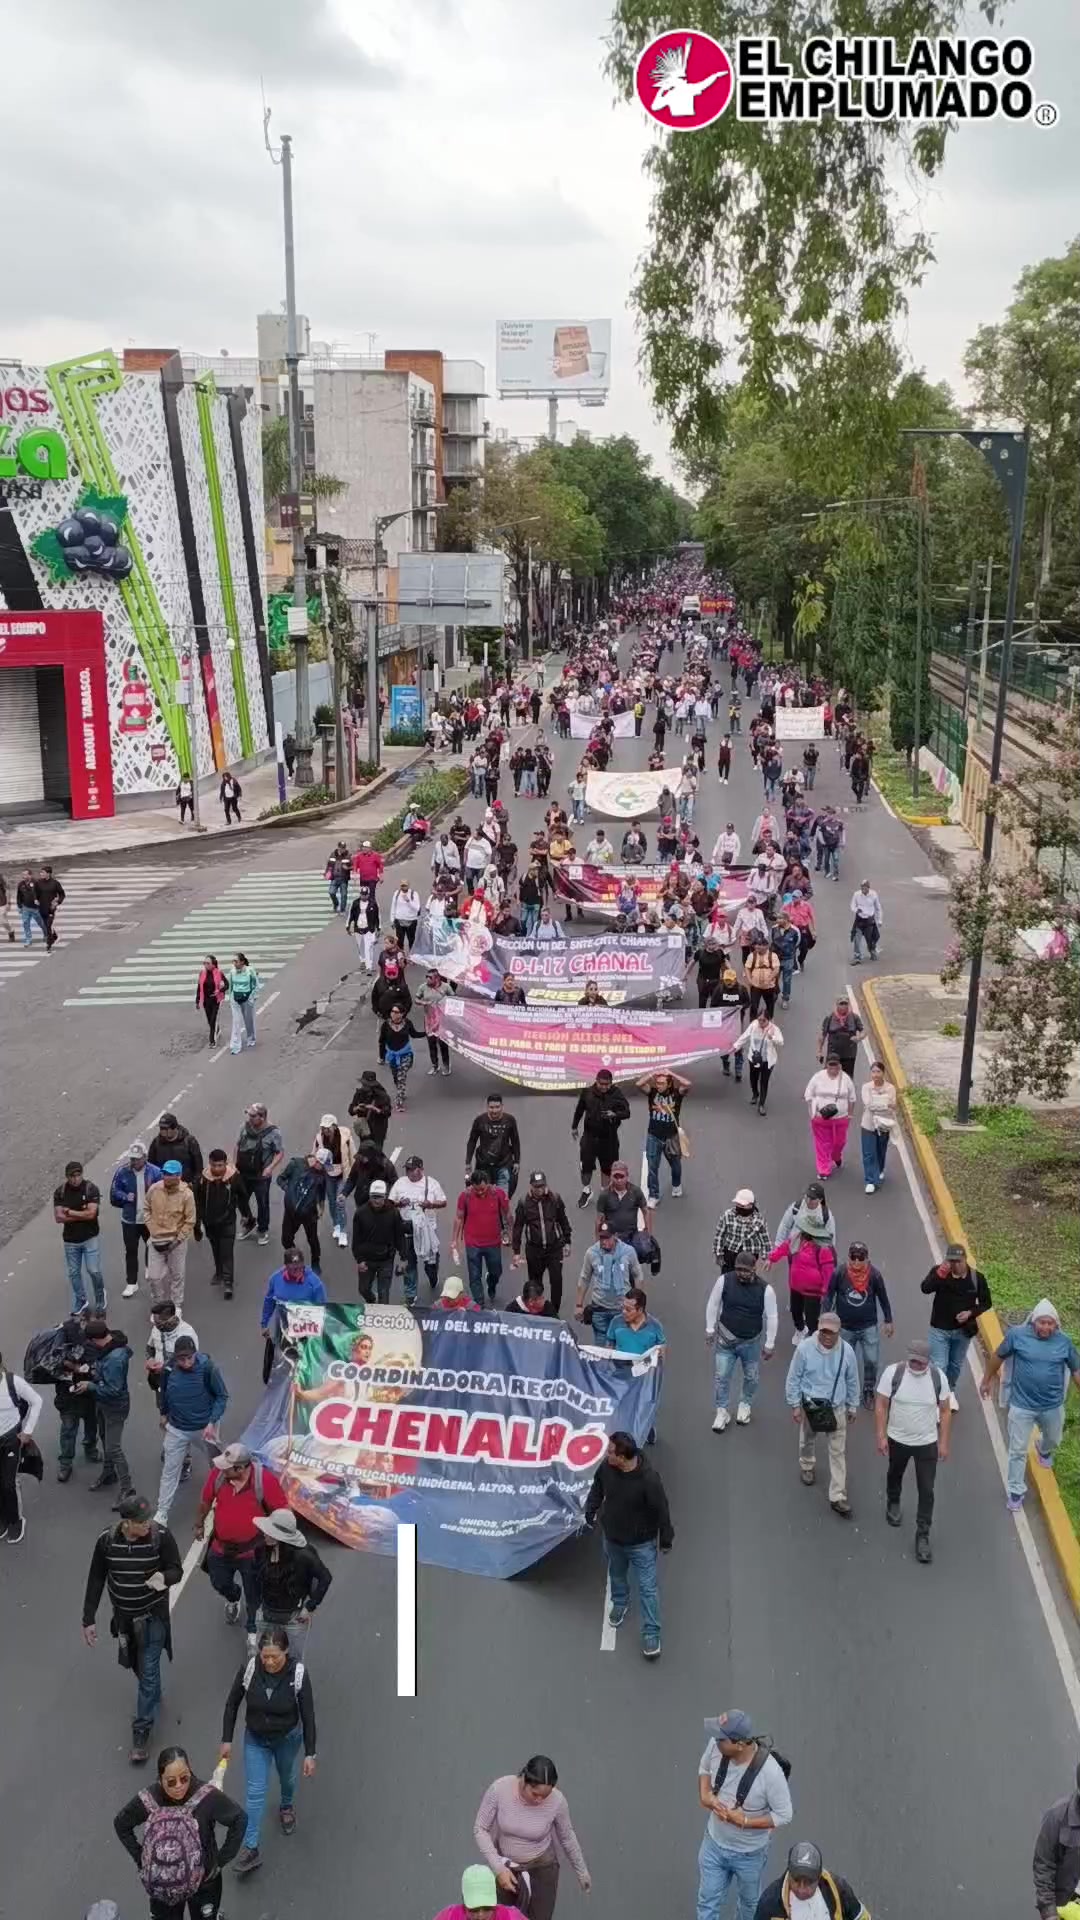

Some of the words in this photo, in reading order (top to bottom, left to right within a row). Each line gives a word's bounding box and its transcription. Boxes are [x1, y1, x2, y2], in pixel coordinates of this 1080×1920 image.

[83, 722, 97, 770] ABSOLUT
[552, 941, 568, 950] DEL
[620, 935, 662, 947] CHIAPAS
[569, 951, 653, 975] CHANAL
[572, 1032, 609, 1042] ALTOS
[356, 1313, 415, 1330] SECCIÓN
[422, 1319, 438, 1331] VII
[444, 1319, 470, 1333] DEL
[474, 1321, 556, 1344] SNTE-CNTE,
[328, 1361, 504, 1396] COORDINADORA
[510, 1375, 613, 1416] REGIONAL
[289, 1450, 324, 1470] NIVEL
[327, 1462, 345, 1474] DE
[347, 1465, 416, 1486] EDUCACIÓN
[417, 1476, 476, 1492] INDÍGENA,
[478, 1482, 516, 1495] ALTOS,
